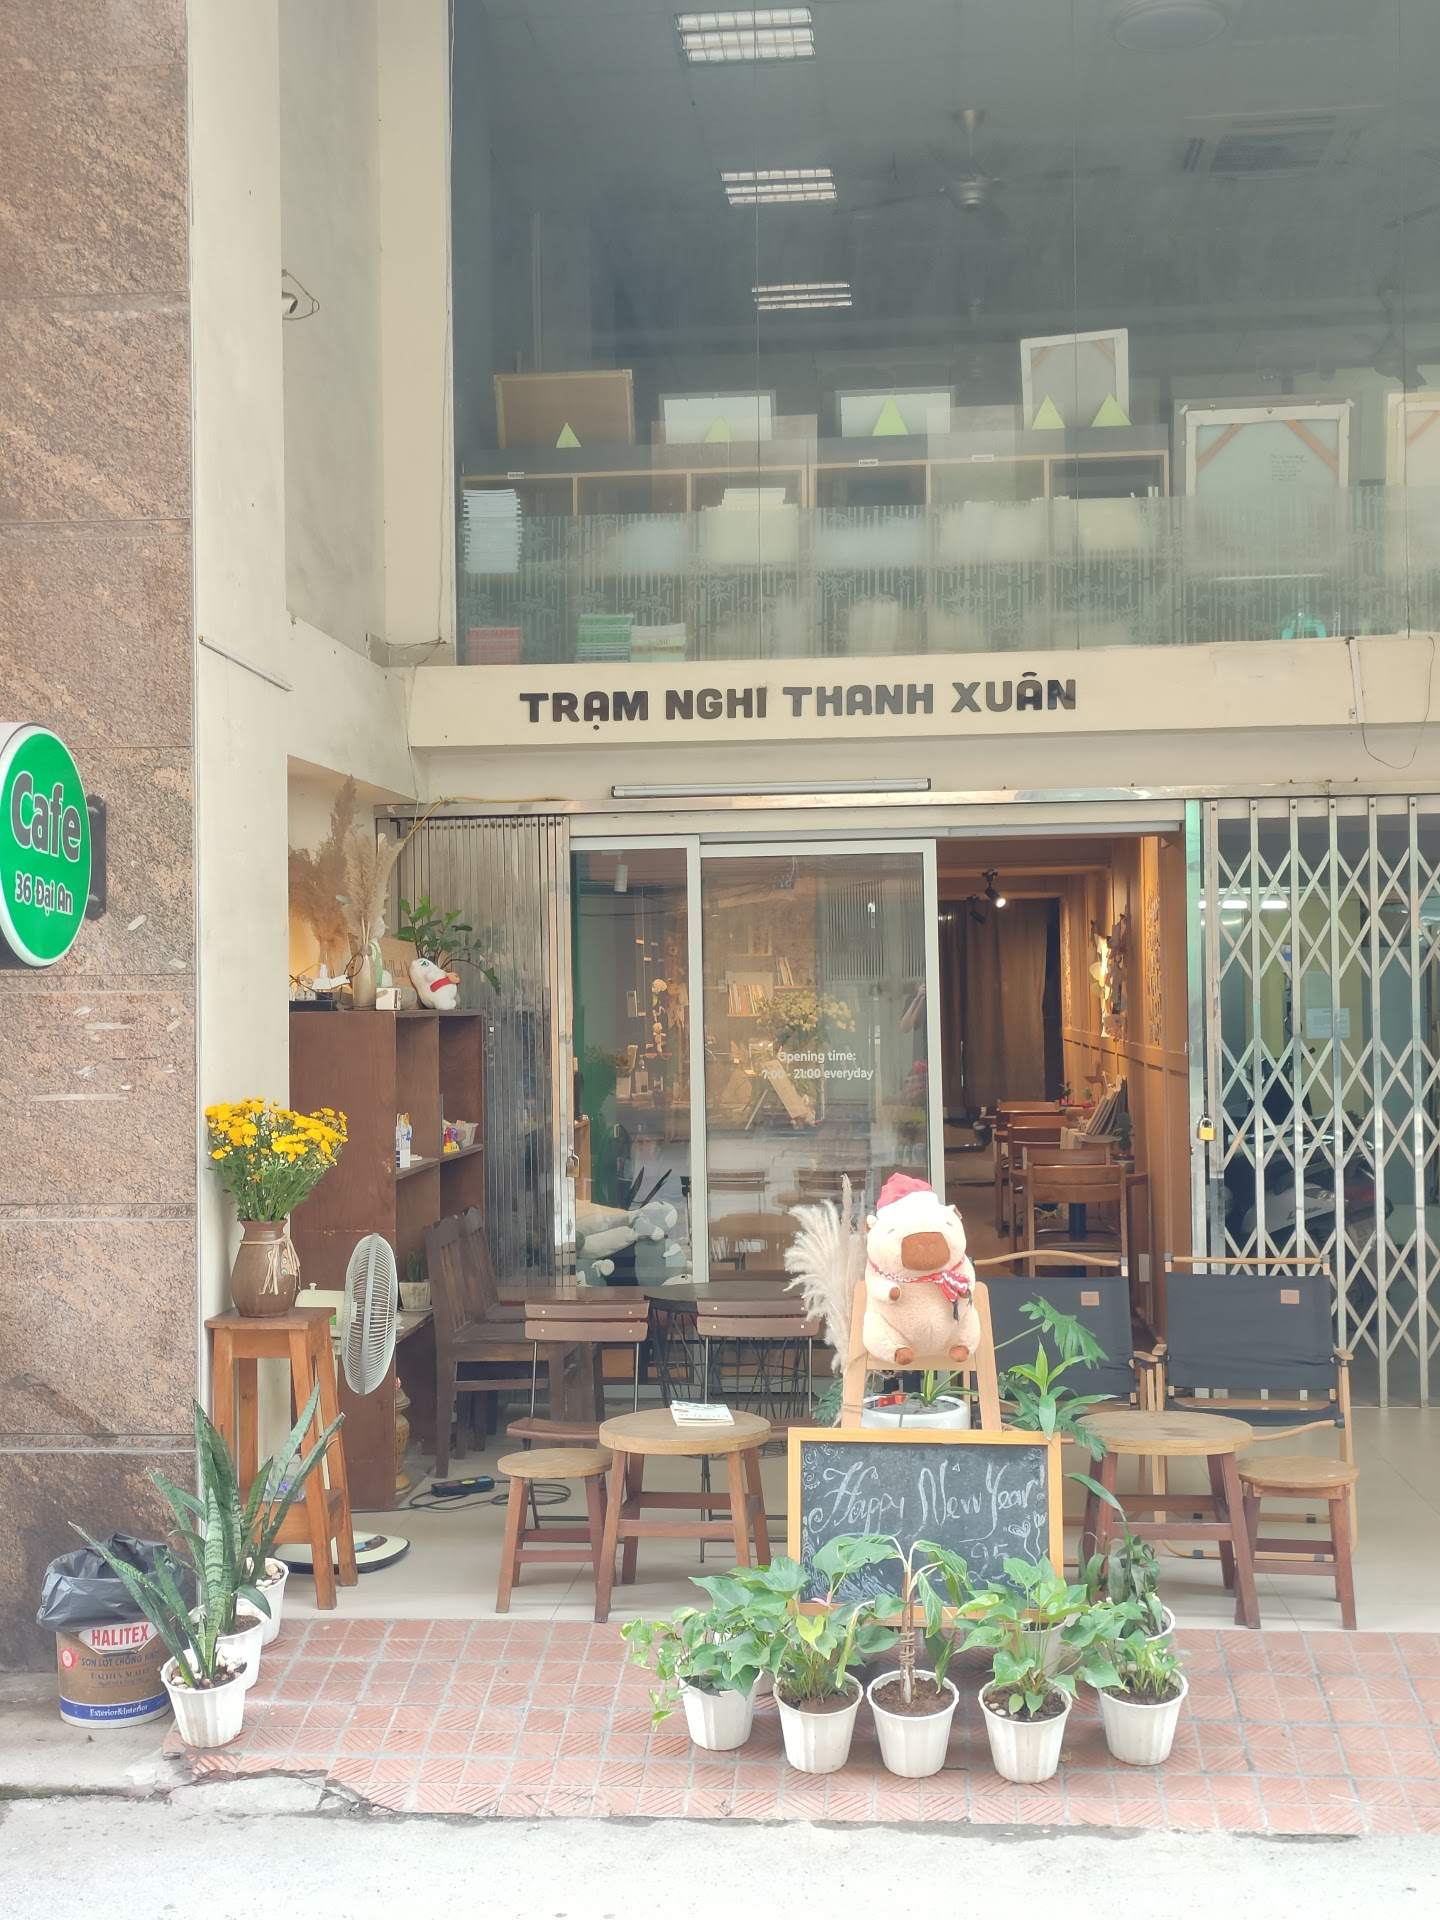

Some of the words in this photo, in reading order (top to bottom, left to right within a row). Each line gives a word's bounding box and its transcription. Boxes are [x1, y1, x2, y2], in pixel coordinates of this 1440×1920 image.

[519, 689, 649, 731] TRẠM
[666, 686, 768, 720] NGHI
[783, 682, 934, 717] THANH
[951, 671, 1077, 714] XUÂN
[11, 771, 81, 862] Cafe
[15, 870, 32, 905] 36
[35, 876, 55, 917] Đại
[57, 882, 74, 915] An
[761, 1069, 785, 1079] 7:00
[793, 1068, 821, 1079] 21:00
[824, 1068, 873, 1080] everyday
[779, 1051, 824, 1063] Opening
[828, 1050, 856, 1060] time:
[809, 1461, 905, 1537] Happy
[905, 1459, 982, 1539] New
[92, 1624, 149, 1646] HALITEX
